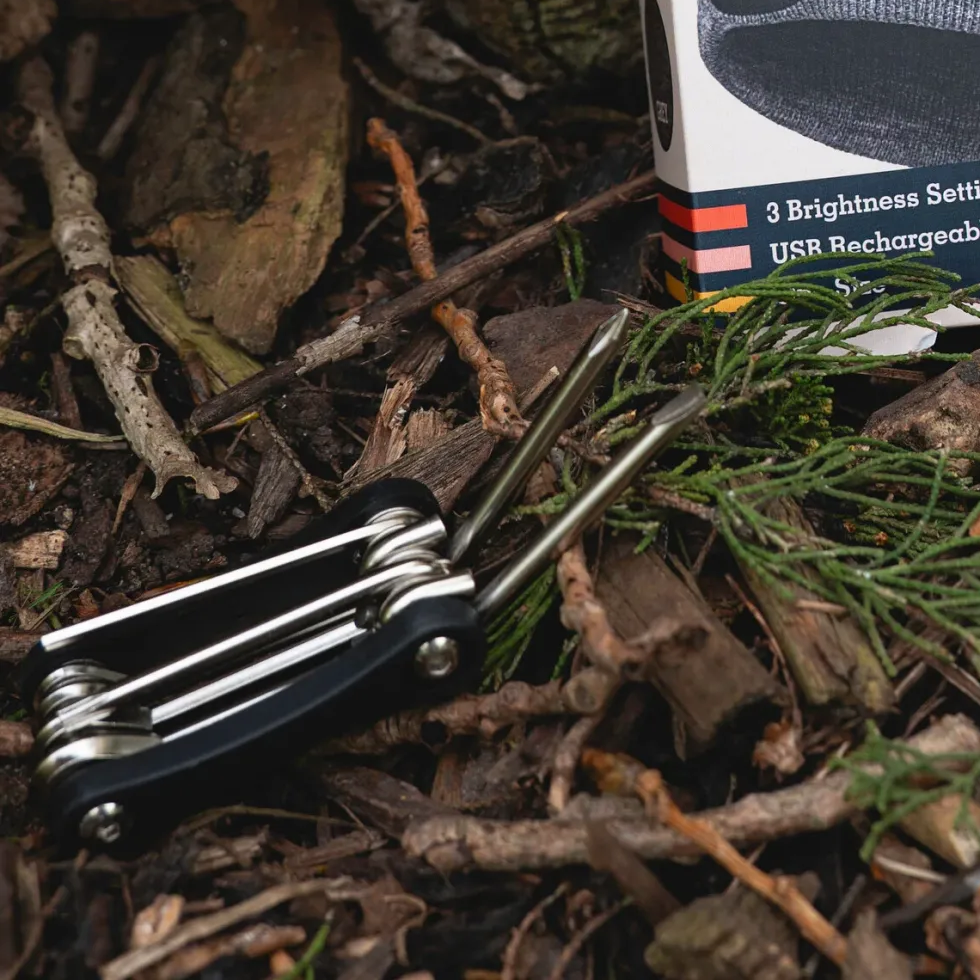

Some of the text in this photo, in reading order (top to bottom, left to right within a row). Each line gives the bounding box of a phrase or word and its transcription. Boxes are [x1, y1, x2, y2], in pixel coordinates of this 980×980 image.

[766, 201, 780, 224] 3
[786, 192, 920, 224] Brightness
[769, 238, 822, 265] USB
